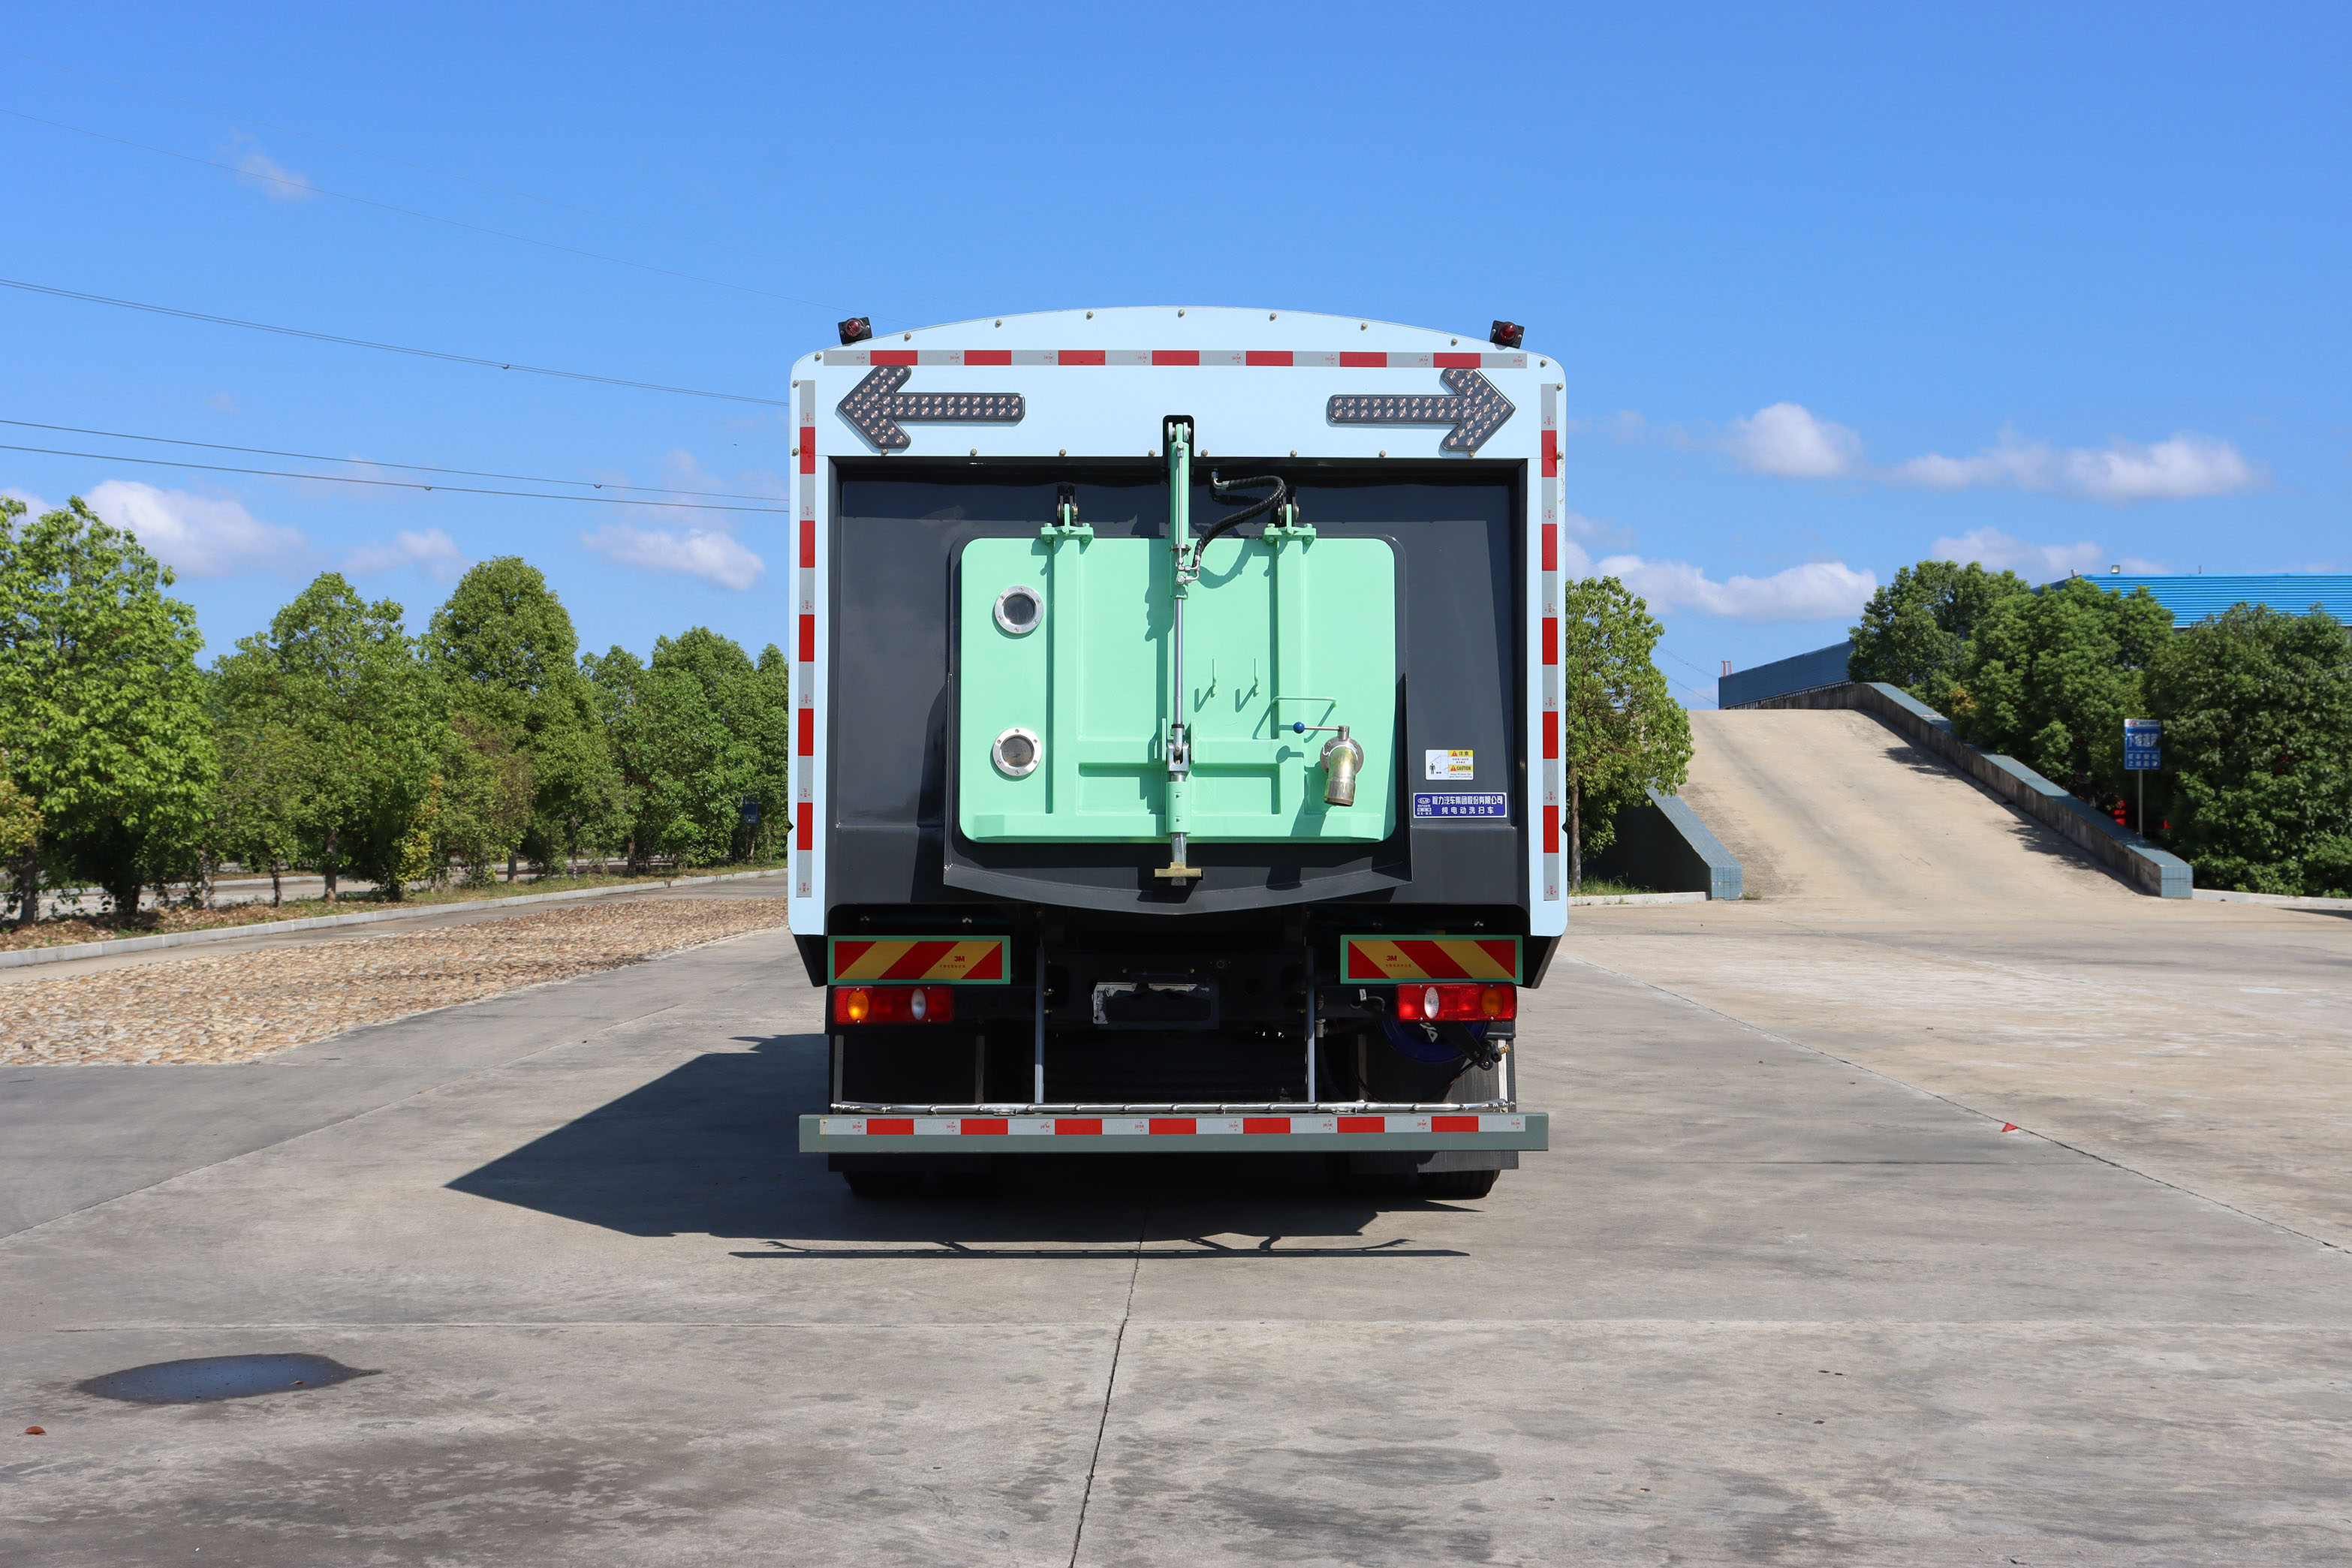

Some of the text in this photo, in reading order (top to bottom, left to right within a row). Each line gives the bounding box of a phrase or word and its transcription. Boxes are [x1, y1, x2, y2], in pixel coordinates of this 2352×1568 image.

[1432, 796, 1503, 805] 程力汽车集团股份有限公司
[1441, 806, 1494, 814] 纯电动洗扫车
